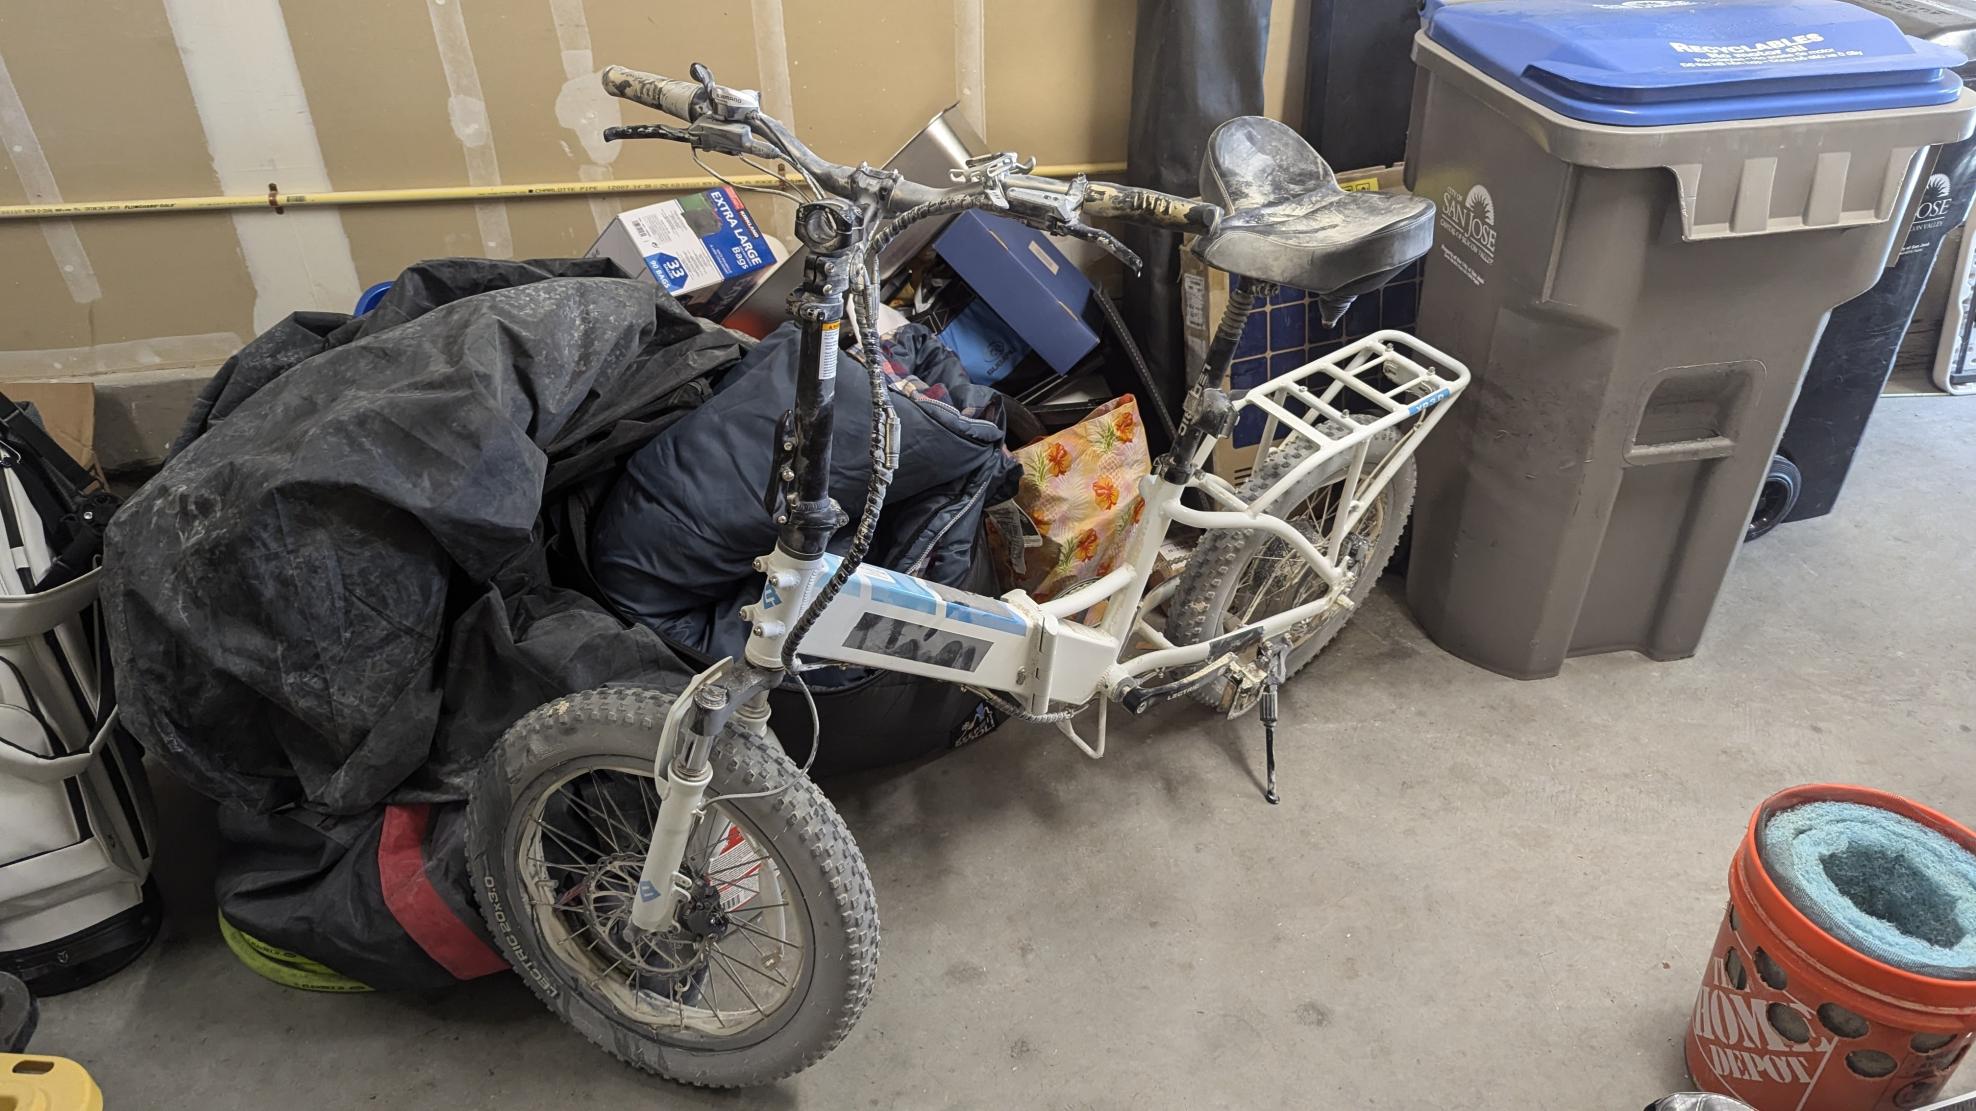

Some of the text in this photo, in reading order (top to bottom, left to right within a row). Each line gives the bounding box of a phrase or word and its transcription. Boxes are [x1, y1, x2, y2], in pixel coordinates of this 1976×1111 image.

[1669, 33, 1824, 53] RECYCLABLES
[1915, 198, 1953, 219] OSE
[711, 191, 738, 228] EXTRA
[734, 228, 762, 266] LARGE
[1442, 192, 1497, 252] SAN JOSE
[666, 259, 685, 278] 33
[731, 246, 749, 270] Bags
[650, 260, 671, 289] 90 BAGS
[1167, 683, 1200, 701] LECTRIC
[484, 876, 558, 997] LECTRIC 20x3.0
[1709, 1044, 1812, 1084] DEPOT
